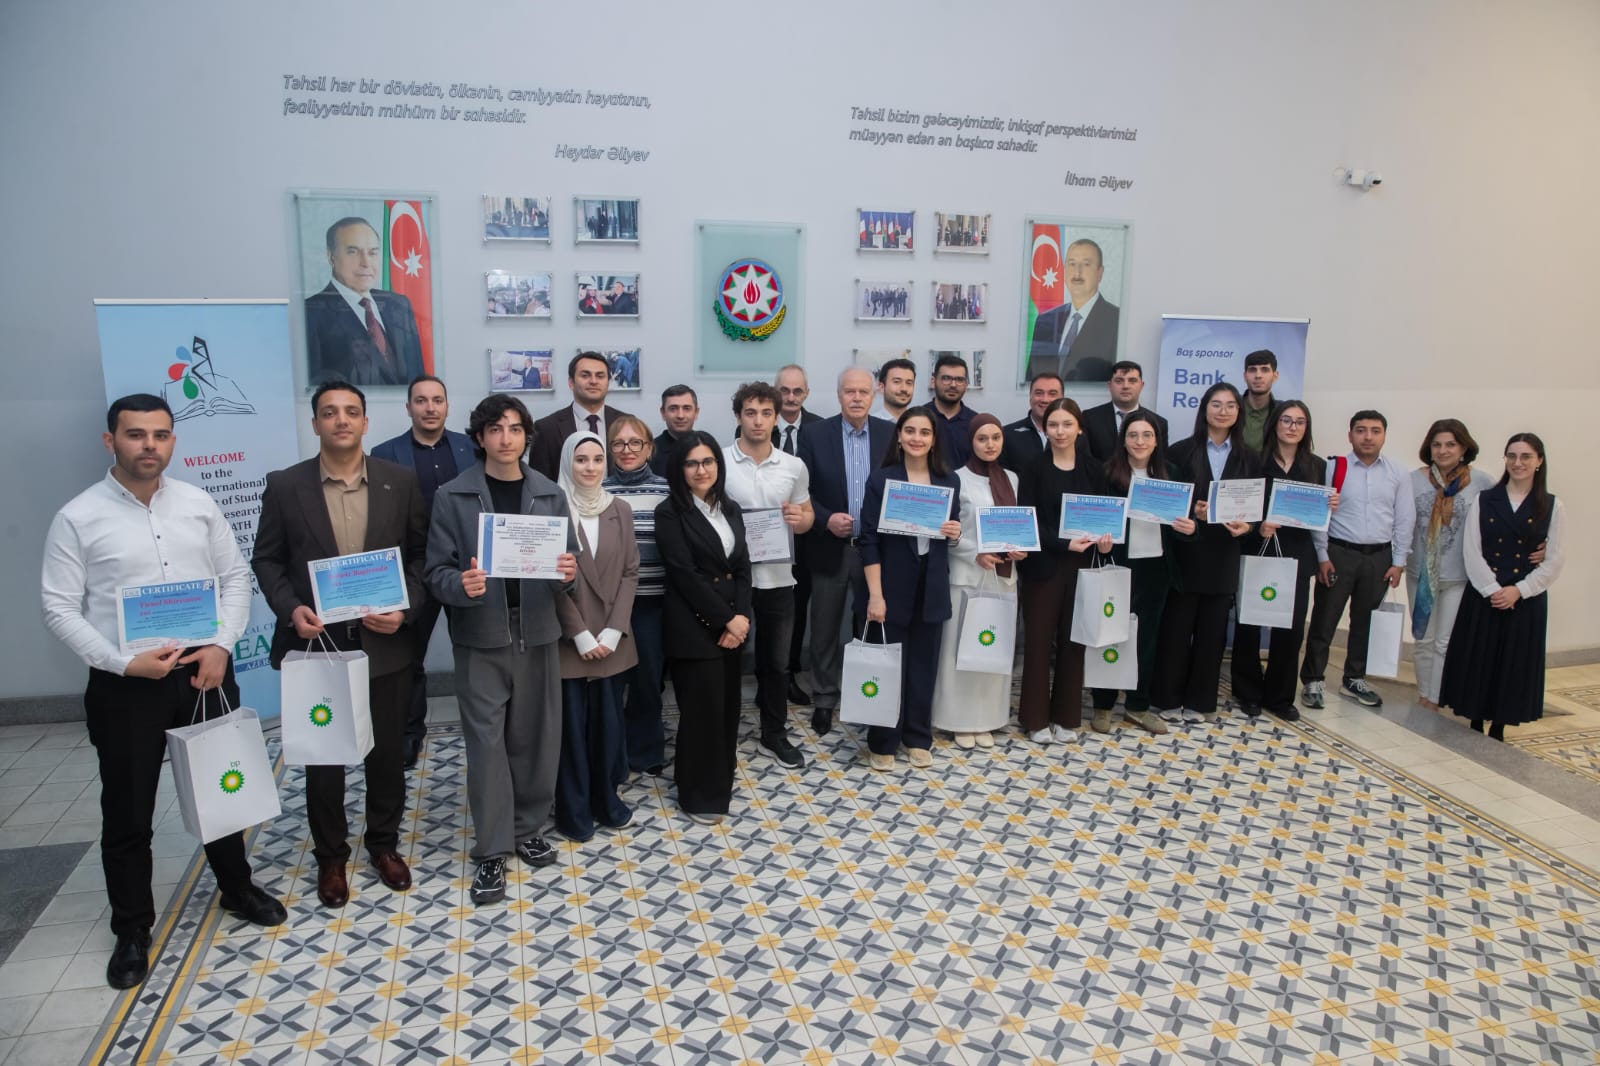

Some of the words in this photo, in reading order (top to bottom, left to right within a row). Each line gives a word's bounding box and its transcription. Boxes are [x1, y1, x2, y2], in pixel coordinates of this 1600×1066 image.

[283, 74, 326, 92] Təhsil
[331, 77, 356, 93] hər
[359, 78, 381, 94] bir
[384, 79, 445, 99] dövlətin,
[449, 81, 504, 102] ölkənin,
[282, 98, 374, 119] fəaliyyətinin
[378, 103, 436, 120] mühüm
[440, 105, 461, 121] bir
[463, 106, 527, 124] sahəsidir.
[851, 106, 885, 122] Təhsil
[887, 109, 920, 125] bizim
[1008, 118, 1046, 136] inkişaf
[848, 128, 903, 146] müəyyən
[906, 131, 935, 146] edən
[937, 135, 952, 147] ən
[955, 134, 994, 151] başlıca
[997, 138, 1038, 153] sahədir.
[554, 143, 604, 163] Heydər
[607, 146, 650, 165] Əliyev
[1064, 170, 1096, 188] İlham
[1099, 175, 1134, 192] Əliyev
[1176, 347, 1193, 358] Baş
[1195, 349, 1234, 359] sponsor
[1174, 368, 1225, 385] Bank
[184, 451, 245, 468] WELCOME
[201, 470, 212, 480] to
[215, 468, 233, 479] the
[201, 477, 266, 494] ternational
[222, 495, 233, 505] of
[142, 582, 201, 595] CERTIFICATE
